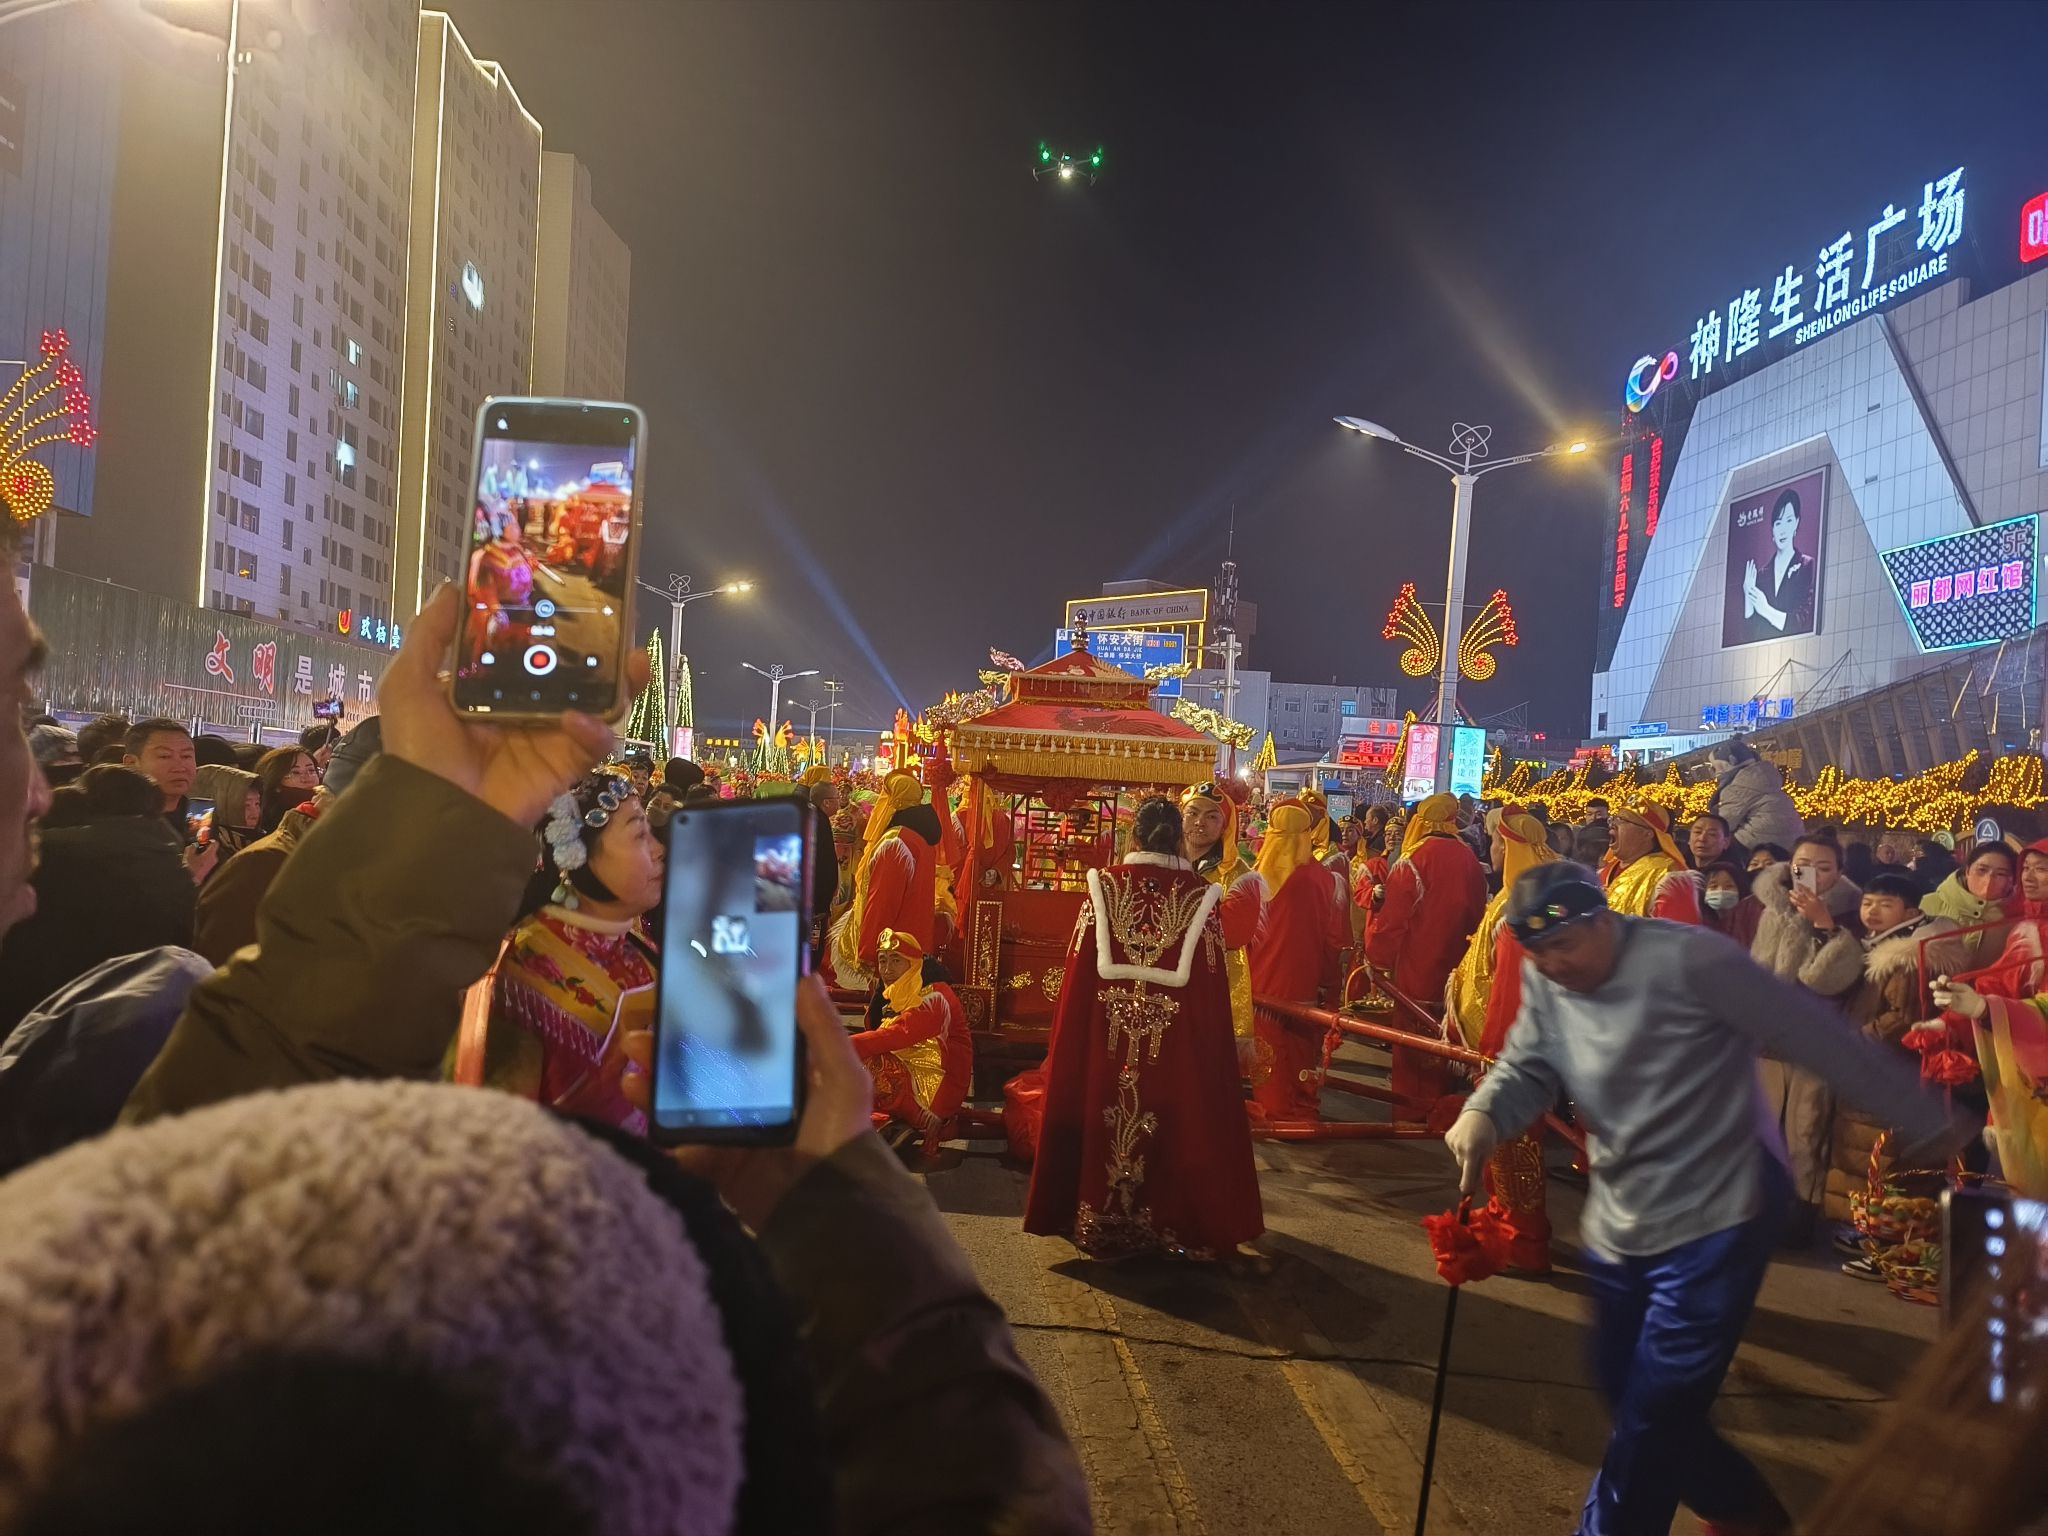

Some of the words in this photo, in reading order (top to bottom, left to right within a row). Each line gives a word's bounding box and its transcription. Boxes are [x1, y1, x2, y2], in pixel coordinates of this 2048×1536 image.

[1689, 166, 1965, 380] 神隆生活广场
[1910, 560, 2024, 609] 丽都网红馆
[1089, 606, 1126, 621] 中国银行
[1131, 607, 1151, 617] BANK
[1153, 607, 1164, 615] OF
[1166, 605, 1189, 614] CHINA
[1097, 634, 1143, 646] 怀安大街
[205, 630, 373, 703] 文明是城市
[1358, 741, 1396, 756] 超市
